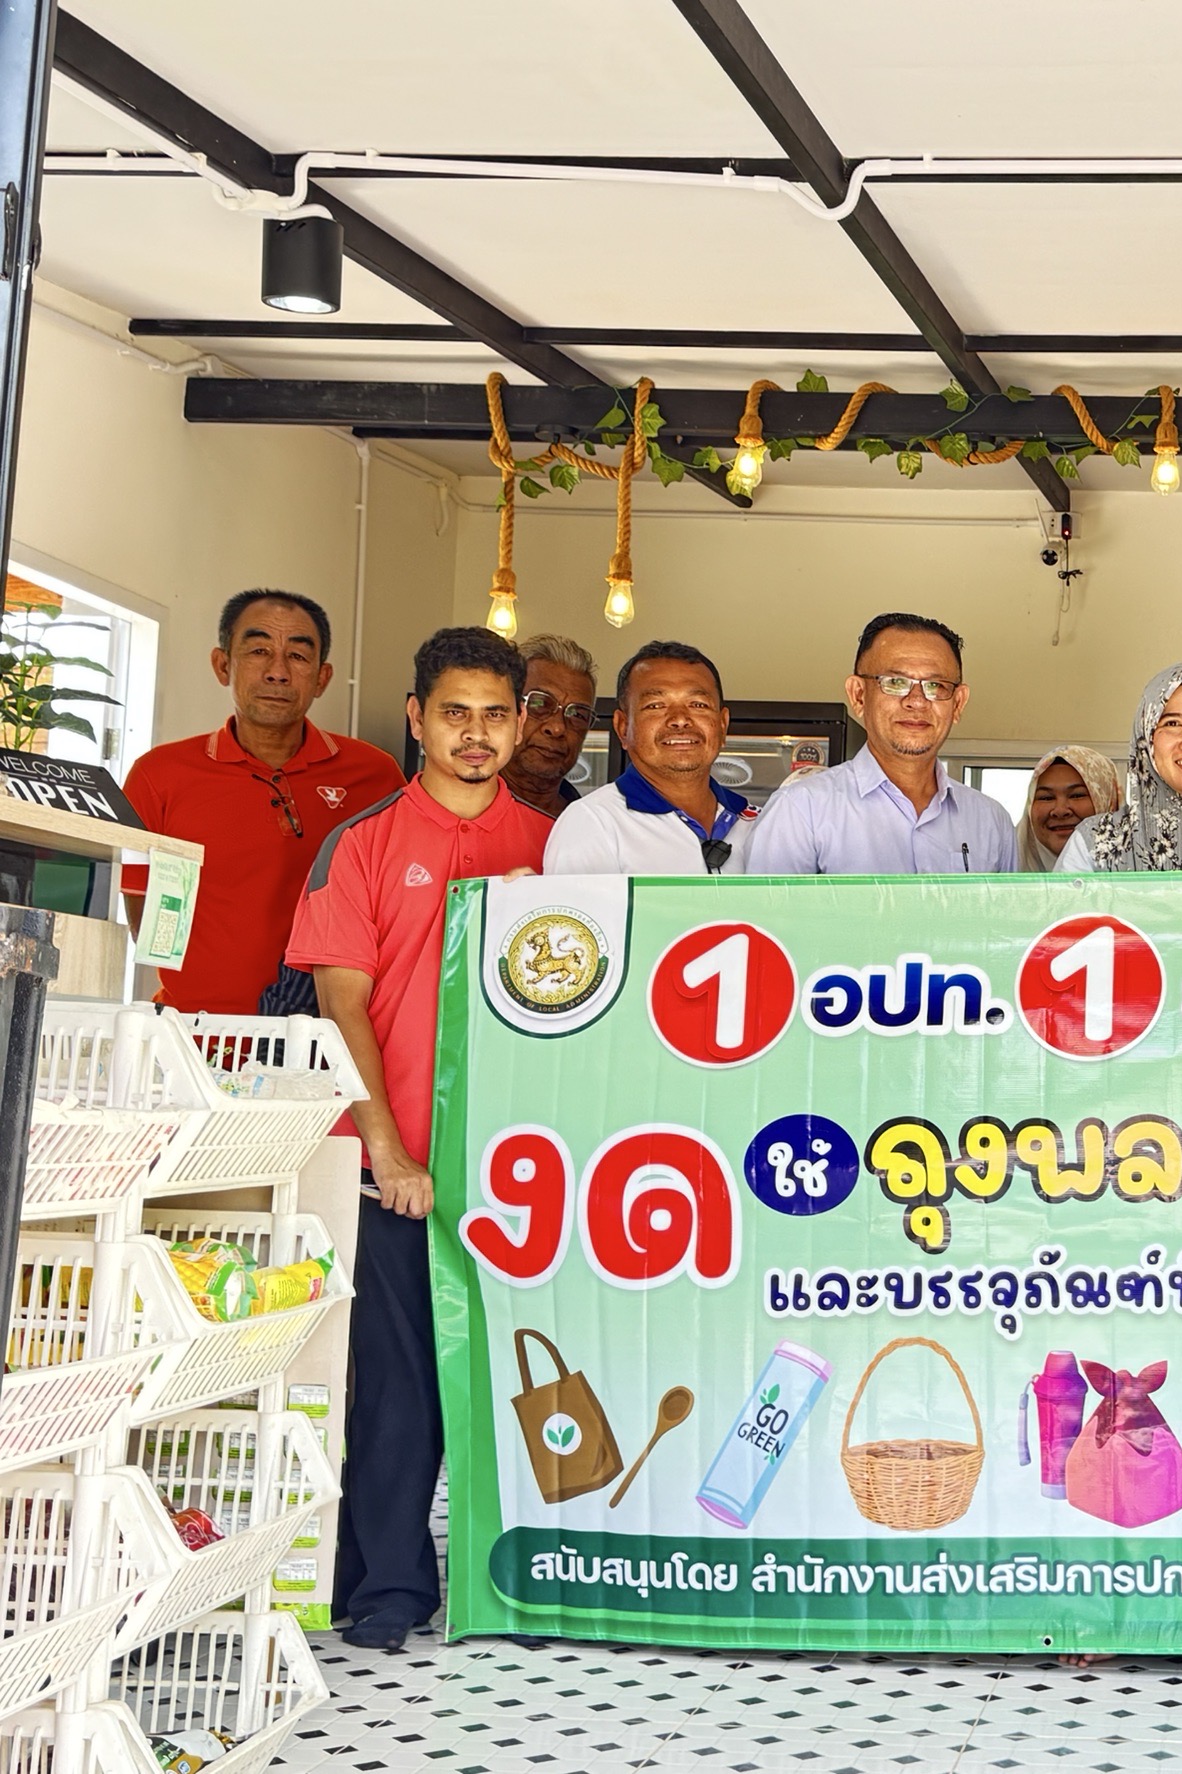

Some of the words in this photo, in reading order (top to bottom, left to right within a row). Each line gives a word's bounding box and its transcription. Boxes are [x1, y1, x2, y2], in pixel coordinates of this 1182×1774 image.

[682, 932, 750, 1050] 1
[809, 961, 1005, 1029] อปท.
[1049, 925, 1116, 1042] 1
[467, 1132, 733, 1281] งด
[766, 1138, 833, 1198] ใช้
[737, 1422, 786, 1458] GREEN
[756, 1403, 789, 1435] GO
[530, 1543, 739, 1600] สนับสนุนโดย
